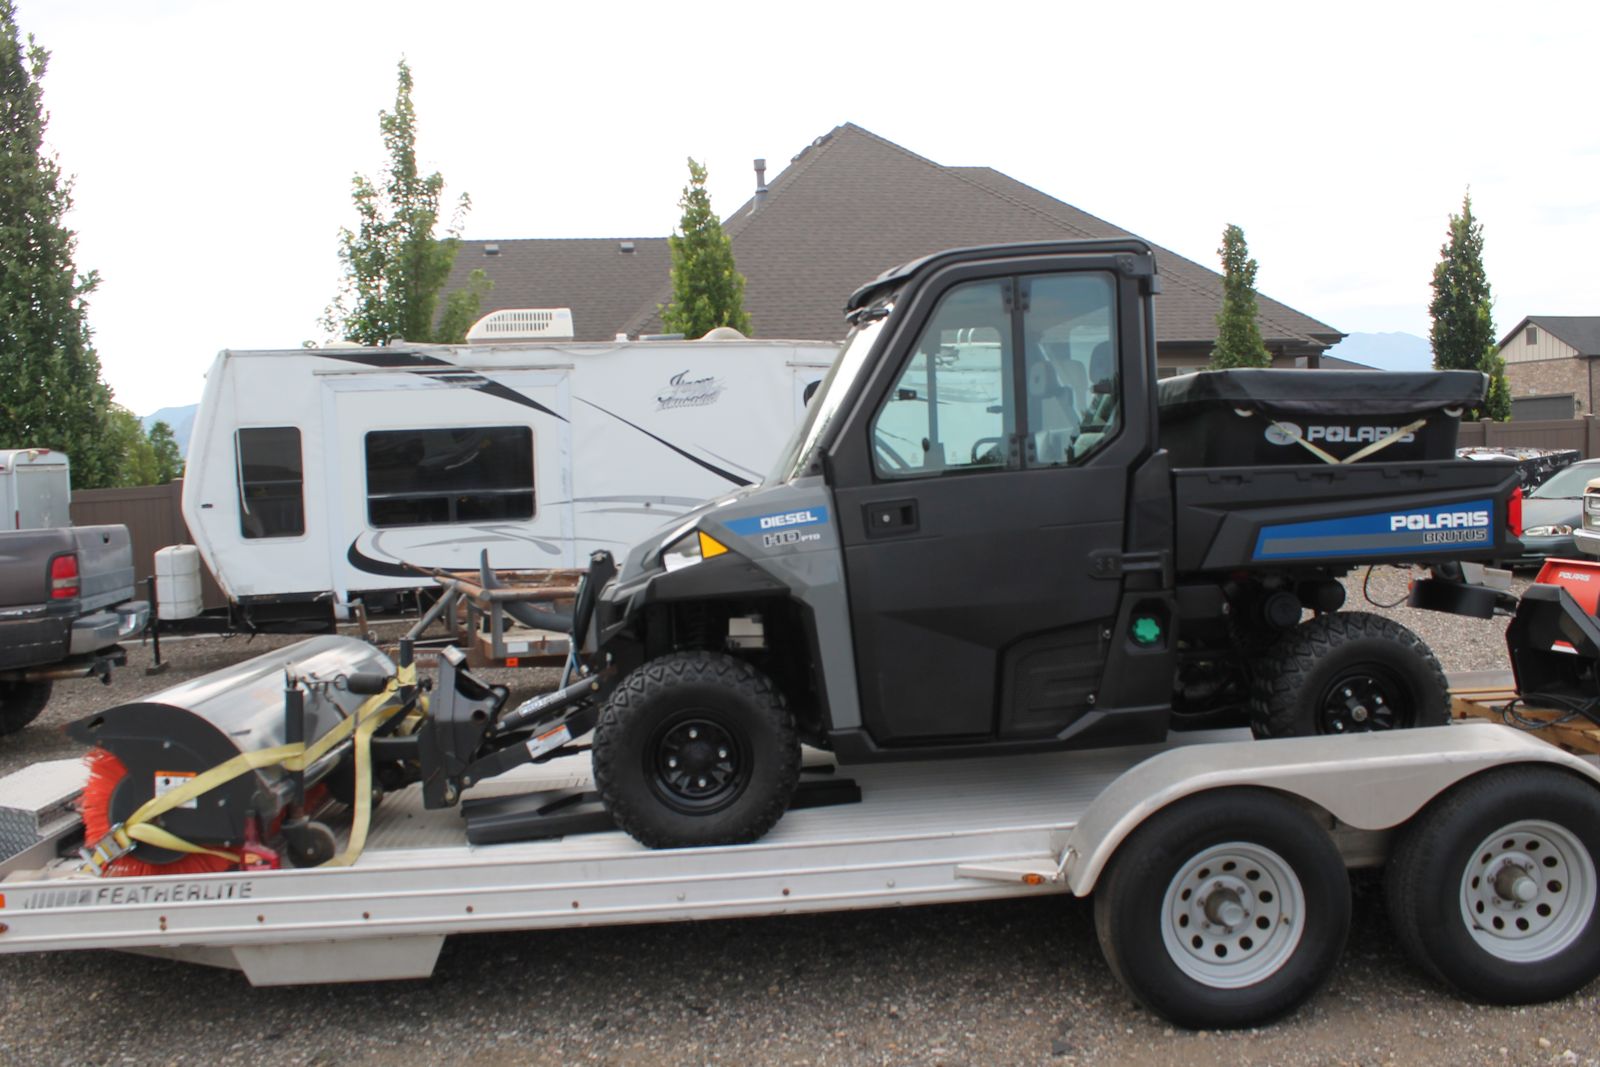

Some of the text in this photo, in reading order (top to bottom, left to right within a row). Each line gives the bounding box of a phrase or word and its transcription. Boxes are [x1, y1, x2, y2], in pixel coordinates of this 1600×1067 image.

[760, 510, 818, 530] DIESEL
[1390, 510, 1489, 531] POLARIS
[1423, 528, 1488, 544] BRUTUS
[96, 882, 253, 905] FEATHERLITE
